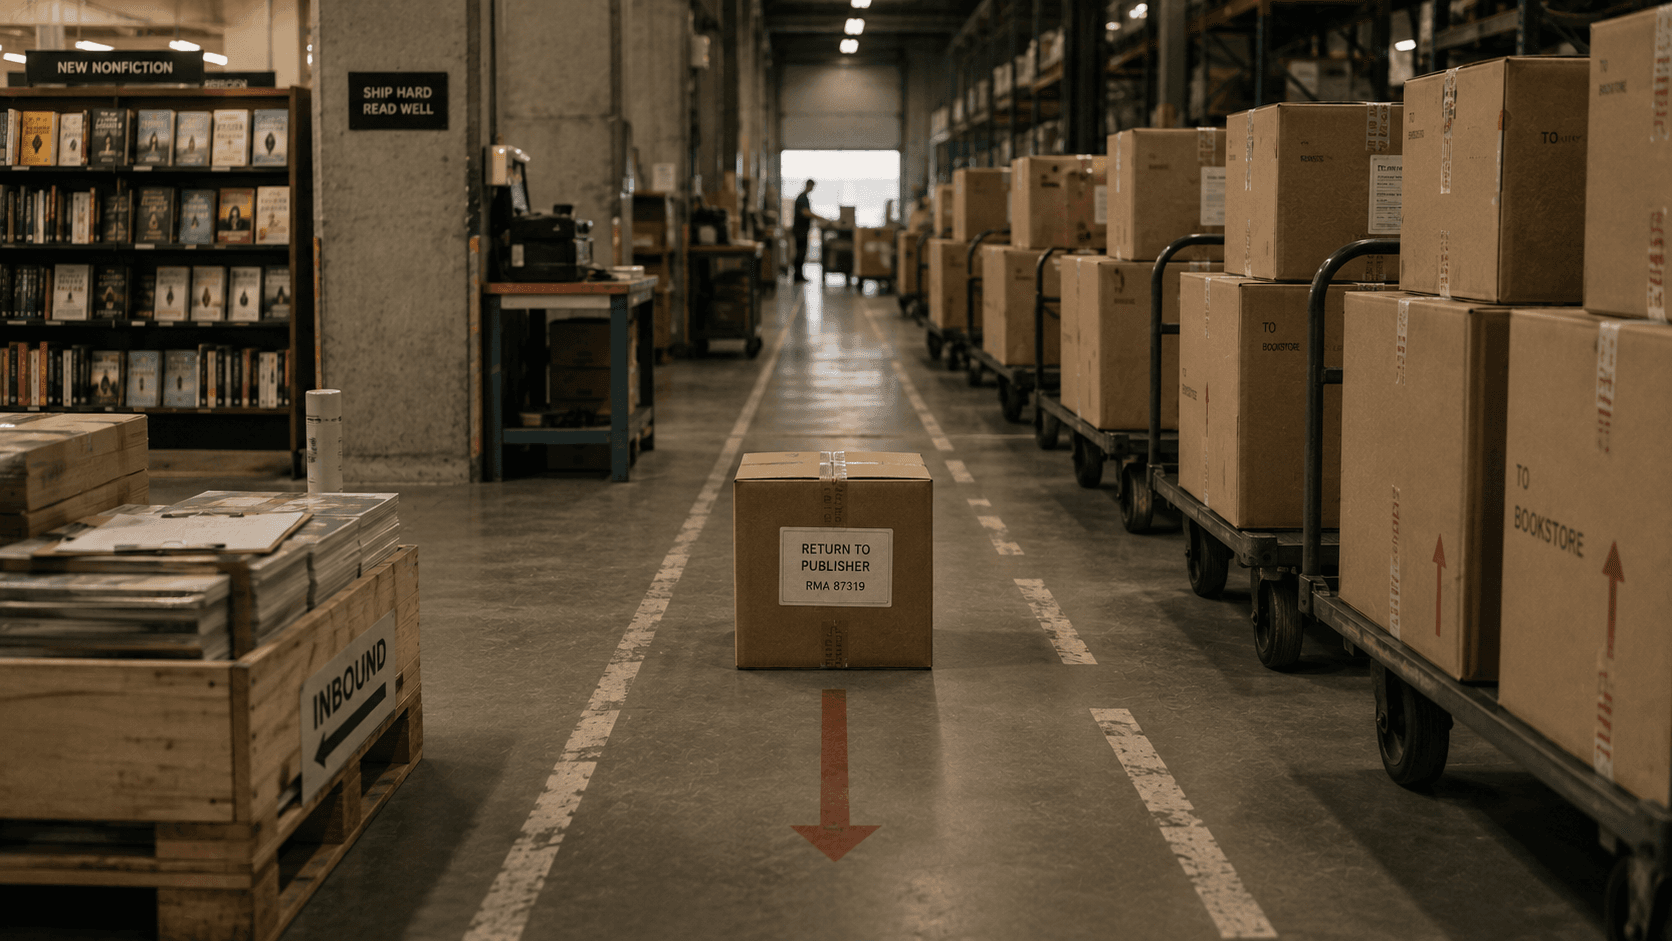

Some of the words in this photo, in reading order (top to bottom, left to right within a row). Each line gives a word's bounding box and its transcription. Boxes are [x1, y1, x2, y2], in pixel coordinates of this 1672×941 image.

[57, 61, 88, 74] NEW
[92, 61, 173, 74] NONFICTION
[363, 86, 393, 99] SHIP
[396, 86, 433, 99] HARD
[363, 103, 397, 115] READ
[400, 103, 434, 115] WELL
[1541, 131, 1558, 144] TO
[1262, 321, 1276, 334] TO
[1516, 463, 1530, 490] TO
[1514, 504, 1585, 559] BOOKSTORE
[801, 543, 851, 555] RETURN
[854, 544, 871, 556] TO
[801, 560, 871, 572] PUBLISHER
[805, 581, 830, 591] RMA
[833, 581, 866, 591] 87319
[313, 638, 387, 731] INBOUND
